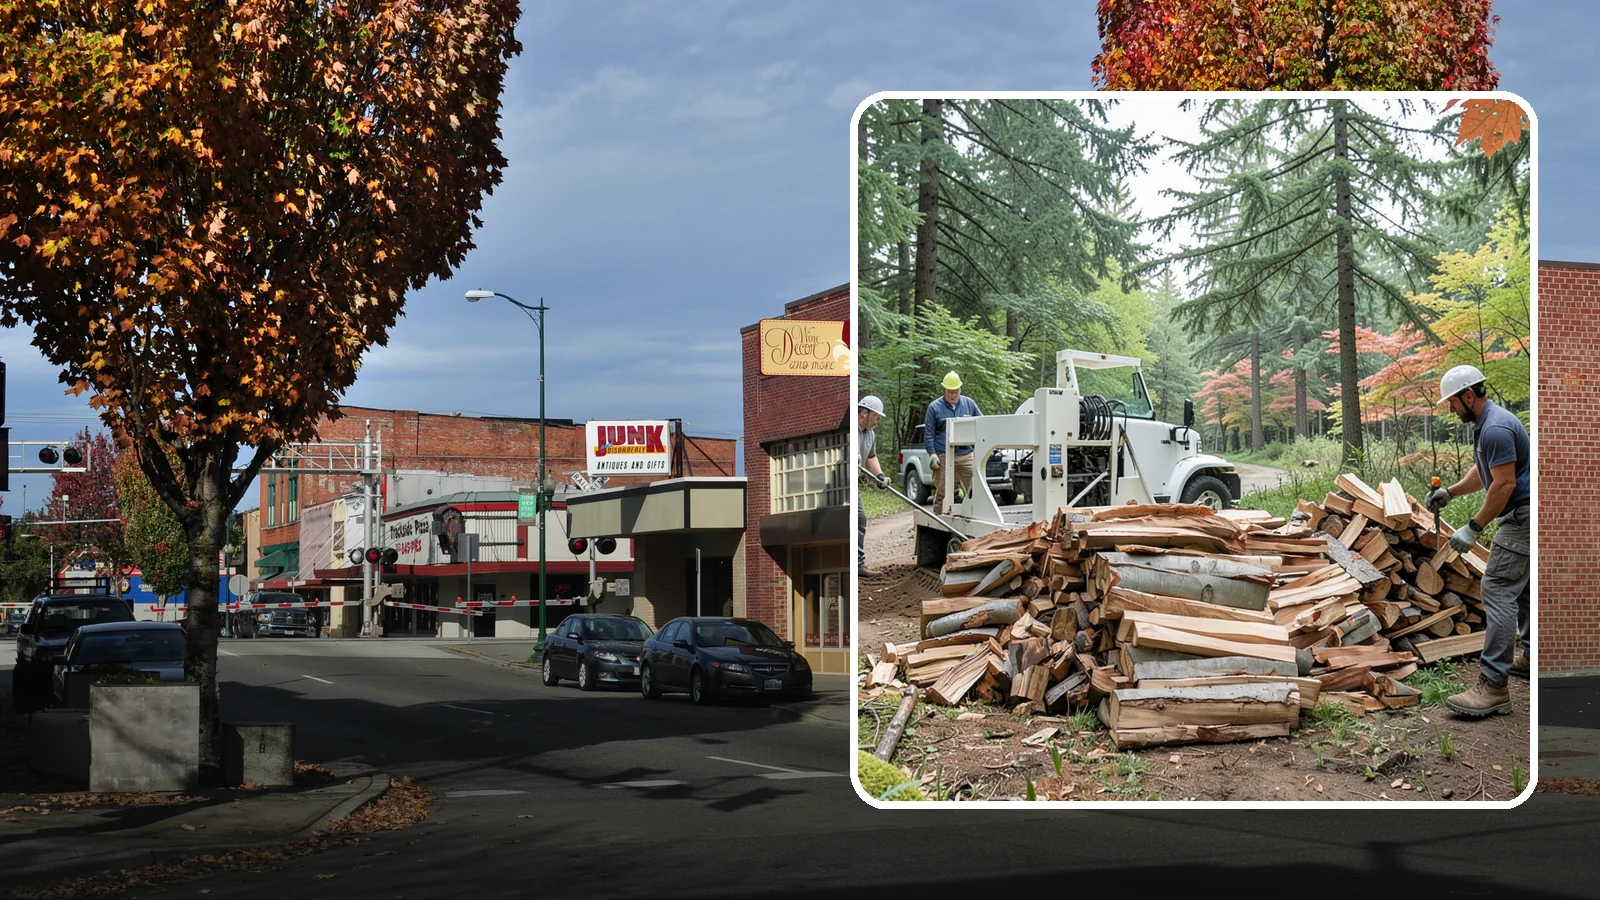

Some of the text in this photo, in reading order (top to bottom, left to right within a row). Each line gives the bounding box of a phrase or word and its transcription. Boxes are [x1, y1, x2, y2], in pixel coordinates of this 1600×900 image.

[595, 425, 665, 457] JUNK
[597, 461, 665, 470] ANTIQUES AND GIFTS
[590, 476, 608, 492] SING
[390, 519, 429, 540] Trackside Pizza
